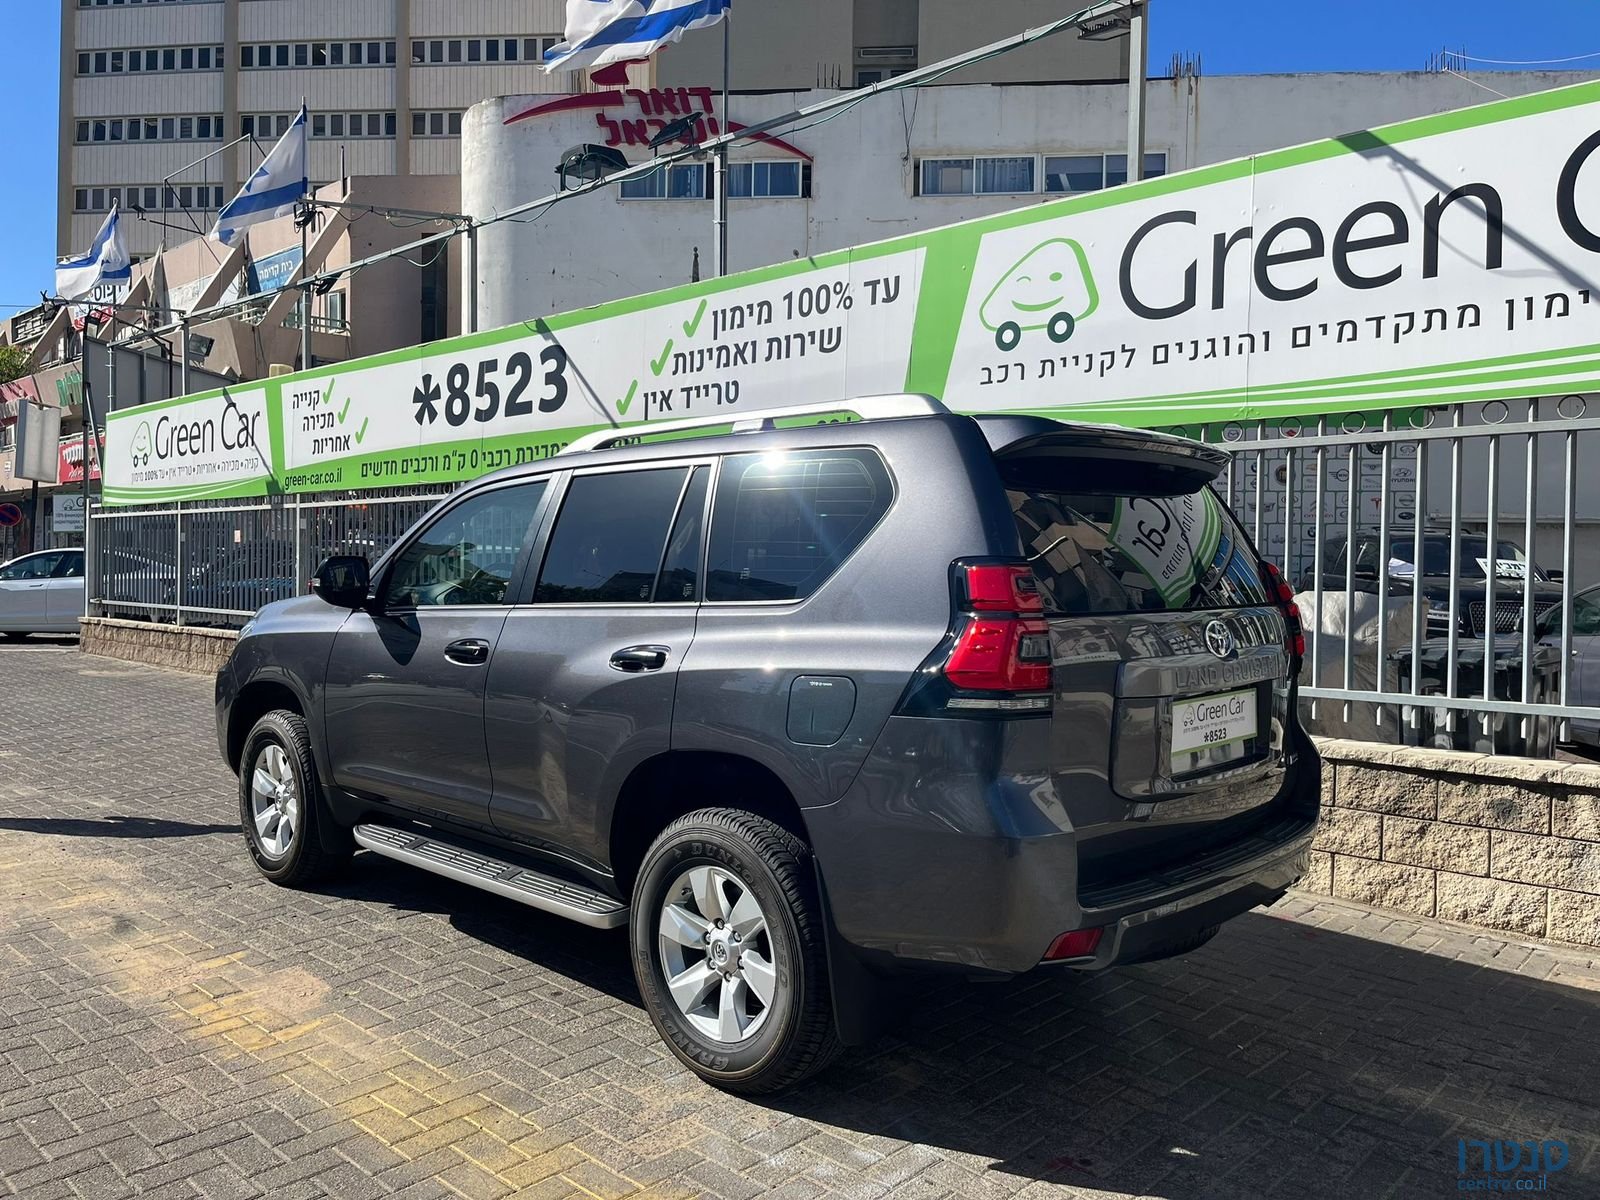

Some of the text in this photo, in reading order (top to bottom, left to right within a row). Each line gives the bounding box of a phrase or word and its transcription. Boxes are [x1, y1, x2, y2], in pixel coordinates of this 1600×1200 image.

[626, 86, 714, 116] דואר
[1118, 182, 1503, 321] Green
[712, 275, 902, 340] עד 100% מימון
[979, 289, 1591, 386] ימון מתקדמים והוגנים לקניית רכב
[672, 326, 842, 376] שירות ואמינות
[292, 389, 320, 411] קנייה
[643, 379, 740, 421] טרייד אין
[155, 402, 260, 460] Green Car
[302, 411, 335, 432] מכירה
[312, 434, 351, 455] אחריות
[221, 460, 240, 472] מכירה
[361, 458, 398, 478] חדשים
[401, 455, 439, 474] ורכבים
[470, 449, 478, 469] 0
[483, 449, 511, 468] רכבי
[284, 467, 342, 490] green-car.co.il
[1175, 655, 1281, 689] LAND CRUISER
[1196, 697, 1245, 722] Green Car
